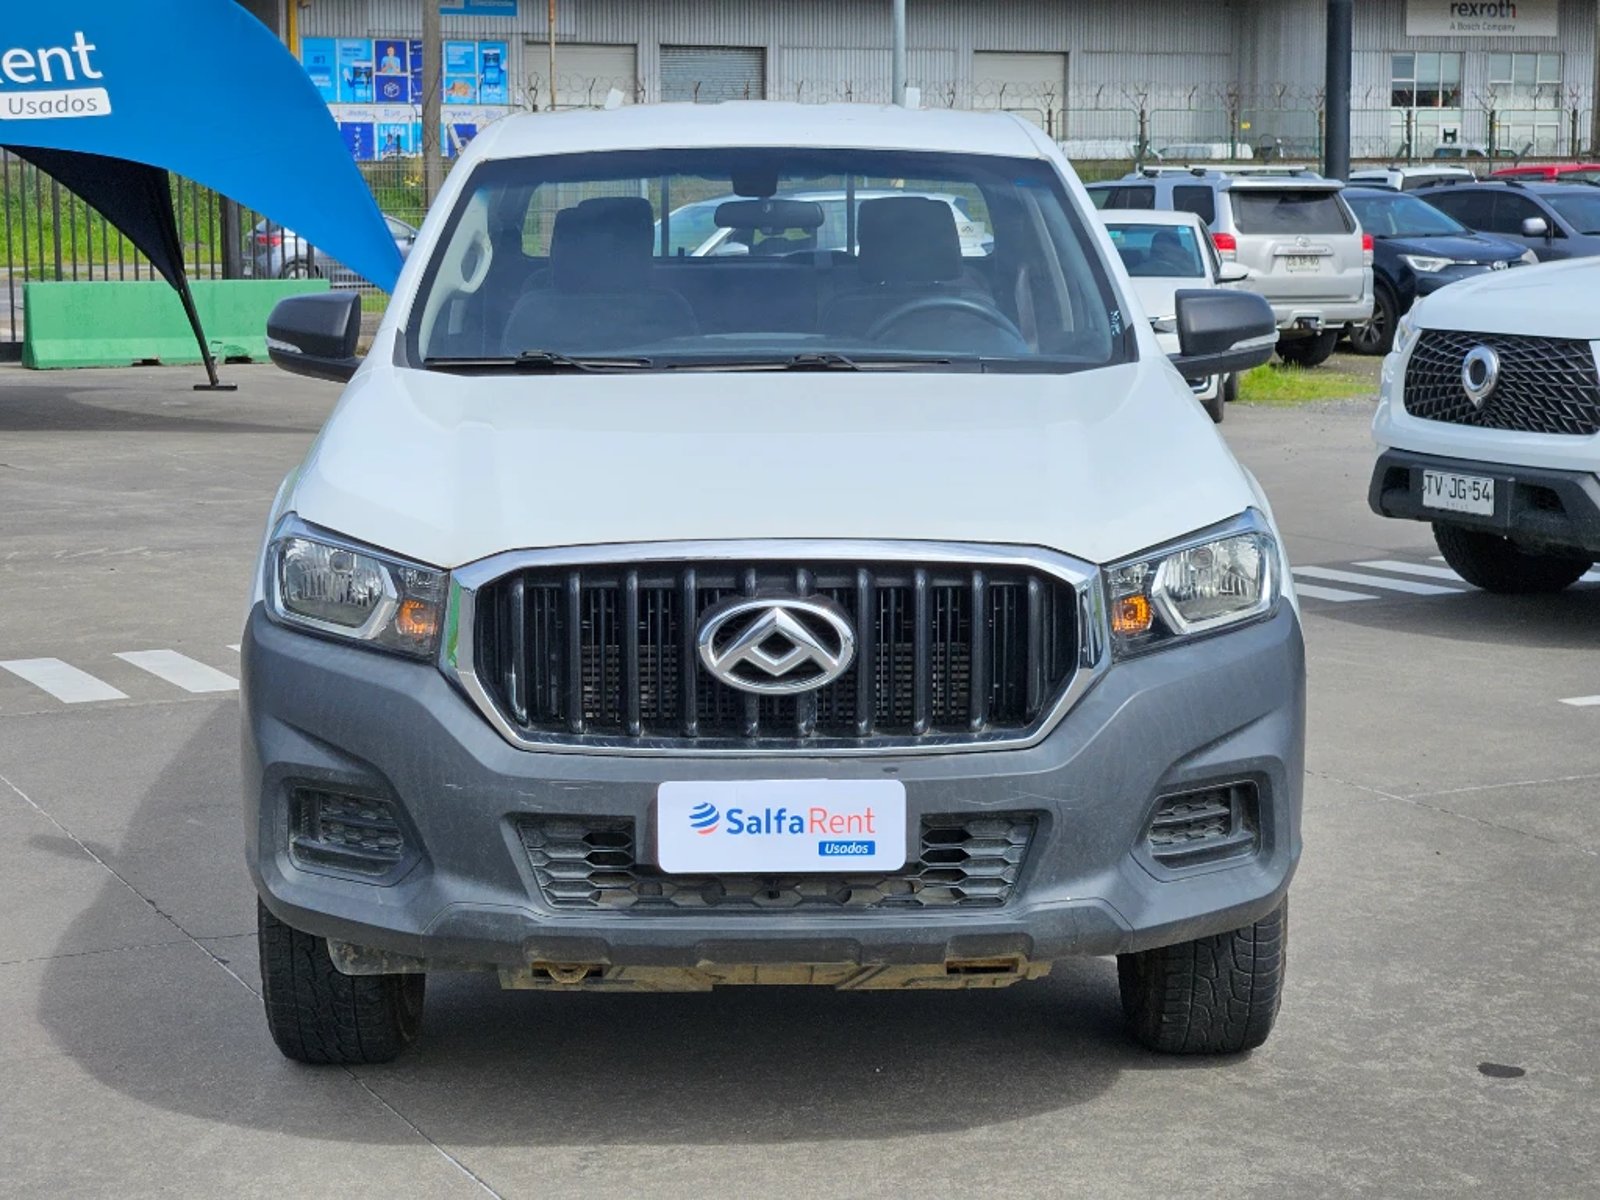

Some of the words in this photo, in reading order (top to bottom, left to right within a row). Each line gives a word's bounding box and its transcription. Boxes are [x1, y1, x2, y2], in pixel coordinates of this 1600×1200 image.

[1450, 0, 1517, 18] rexroth
[1449, 22, 1456, 31] A
[1457, 21, 1480, 31] Bosch
[1482, 21, 1516, 32] Company
[0, 31, 103, 84] ent
[8, 94, 98, 115] Usados
[824, 842, 869, 854] Usados
